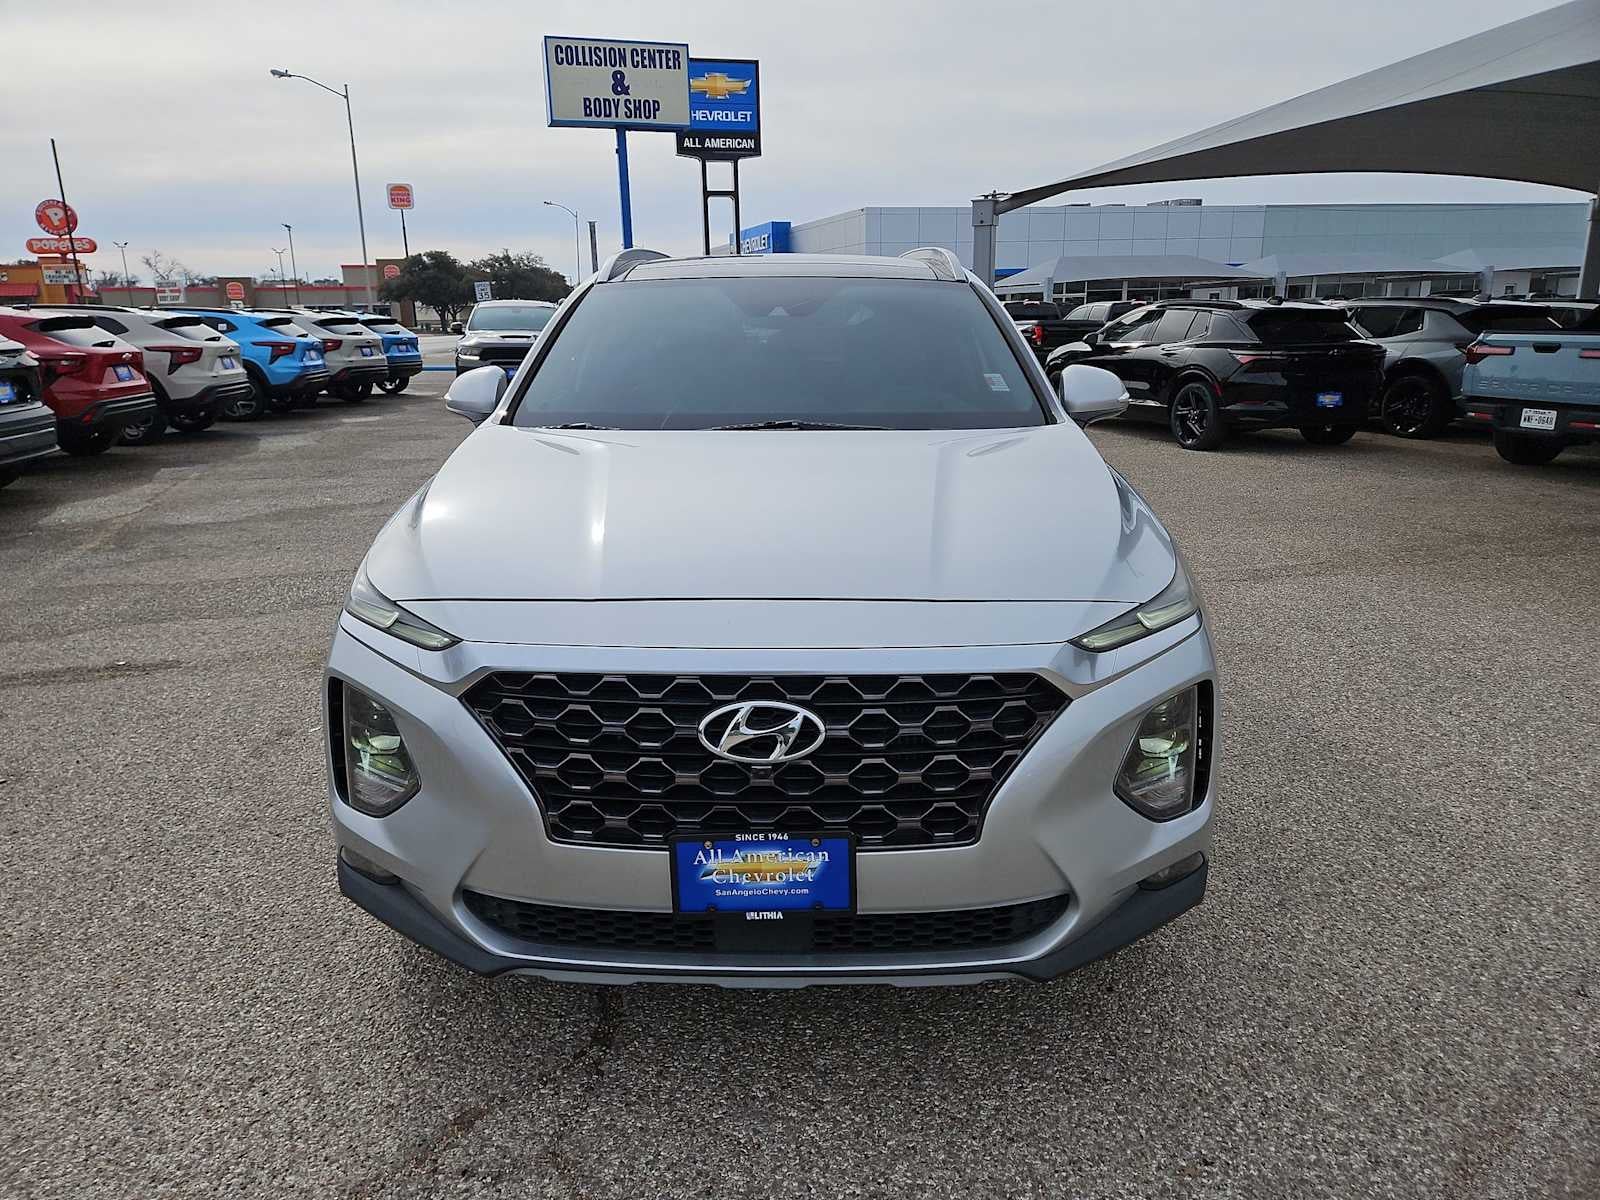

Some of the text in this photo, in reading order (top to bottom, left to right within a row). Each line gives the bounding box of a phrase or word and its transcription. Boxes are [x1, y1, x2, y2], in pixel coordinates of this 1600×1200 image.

[554, 44, 681, 70] COLLISION CENTER
[611, 69, 631, 96] &
[583, 97, 661, 120] BODY SHOP
[690, 109, 753, 123] HEVROLET
[683, 137, 755, 149] ALL AMERICAN
[478, 291, 490, 300] 35
[735, 833, 789, 842] SINCE 1946
[693, 848, 830, 865] All American
[712, 867, 815, 884] Chevrolet
[715, 888, 809, 897] SanAngeloChevy.com
[754, 911, 784, 920] LITHIA
